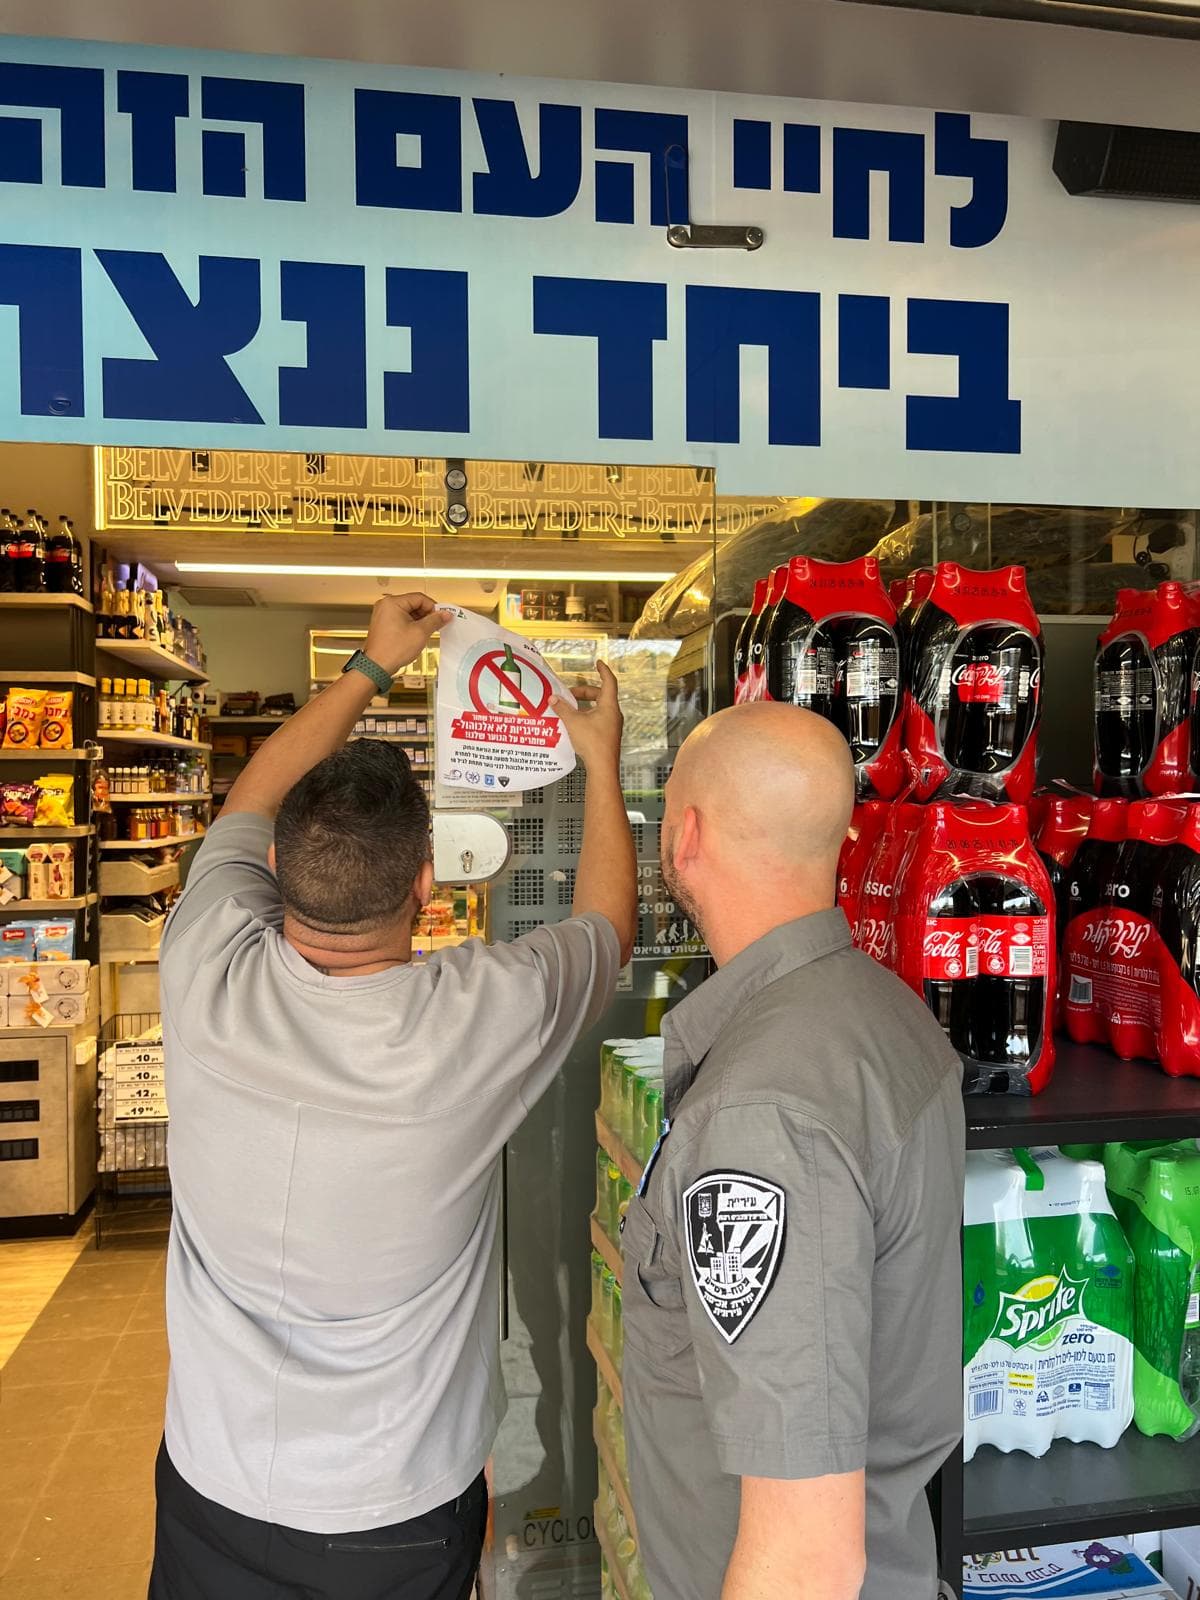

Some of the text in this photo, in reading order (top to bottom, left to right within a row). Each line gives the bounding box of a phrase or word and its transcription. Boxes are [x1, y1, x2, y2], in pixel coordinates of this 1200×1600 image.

[0, 62, 1009, 249] לחיי העם הזה
[532, 275, 1021, 456] ביחד
[107, 480, 293, 529] BELVEDERE
[470, 492, 638, 538] BELVEDERE
[638, 497, 780, 537] BELVEDER
[496, 723, 508, 733] לא
[510, 724, 540, 735] סיגריות
[541, 726, 554, 736] לא
[509, 733, 519, 742] על
[519, 735, 546, 745] שומרים
[840, 877, 848, 893] 6
[864, 880, 893, 898] SSIC
[1070, 880, 1080, 897] 6
[639, 902, 675, 915] 3:00
[633, 946, 661, 955] סיאס
[136, 1054, 150, 1062] 10
[136, 1072, 150, 1080] 10
[135, 1089, 150, 1098] 12
[726, 1196, 757, 1208] עיריית
[1000, 1282, 1076, 1340] Sprite
[1062, 1333, 1095, 1346] zero
[524, 1515, 601, 1546] CYCLO
[978, 1572, 1024, 1583] בטעם
[1026, 1563, 1065, 1581] ענבים
